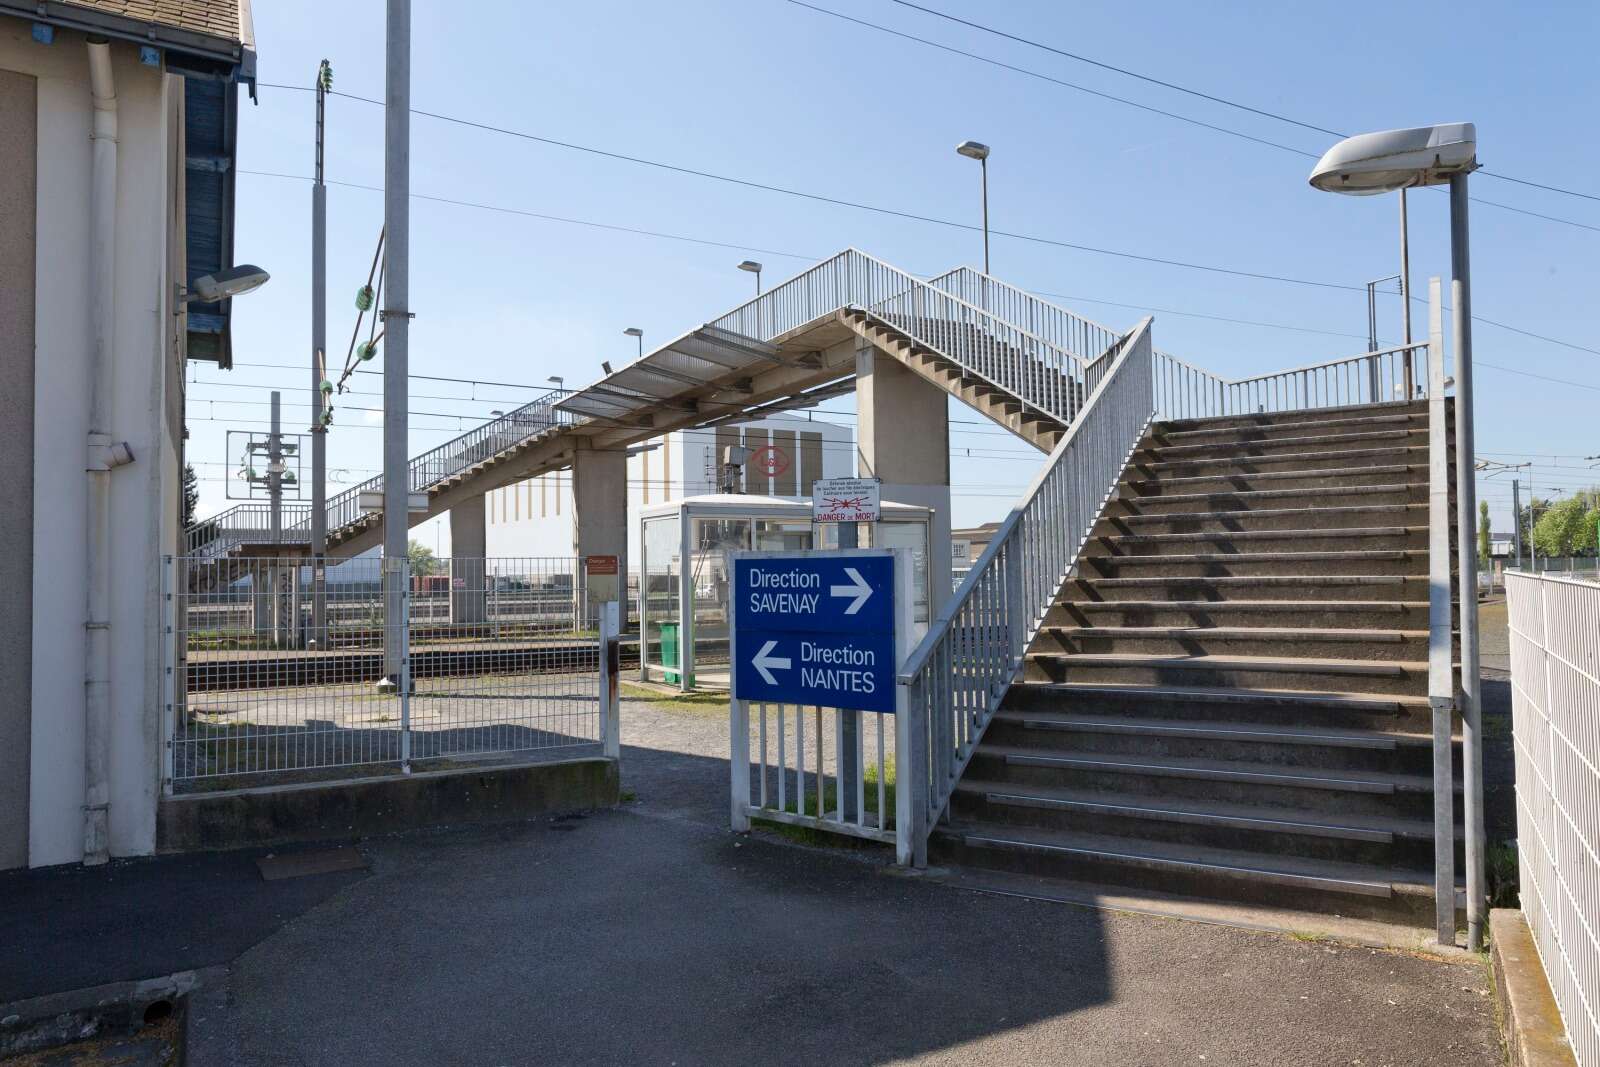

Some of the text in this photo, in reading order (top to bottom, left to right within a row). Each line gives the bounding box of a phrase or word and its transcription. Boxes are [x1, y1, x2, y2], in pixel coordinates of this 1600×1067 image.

[817, 513, 846, 521] DANGER
[855, 512, 876, 520] MORT
[750, 568, 820, 588] Direction
[750, 592, 820, 614] SAVENAY
[800, 641, 875, 666] Direction
[801, 667, 875, 693] NANTES
